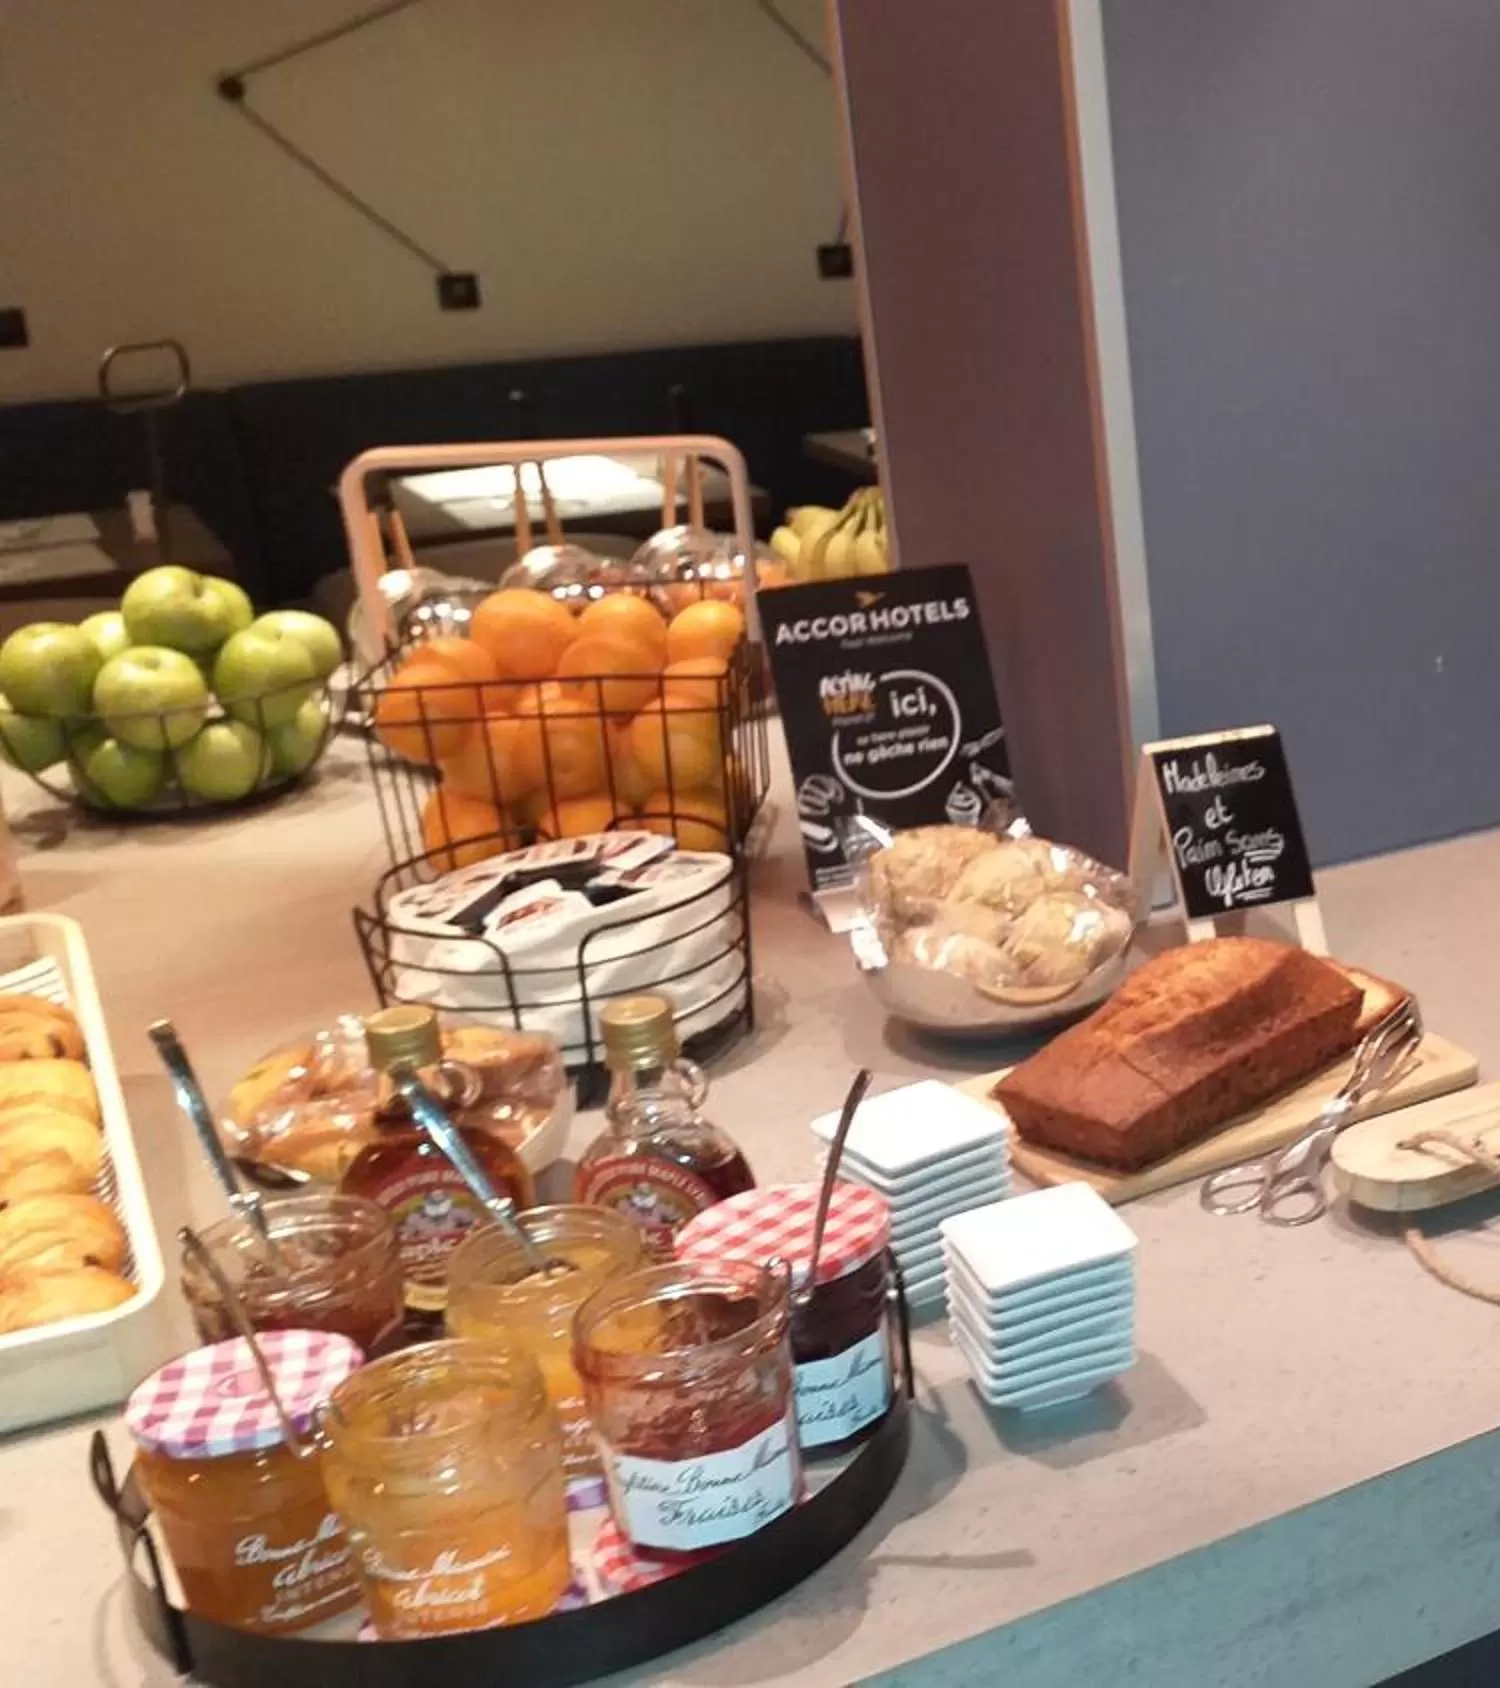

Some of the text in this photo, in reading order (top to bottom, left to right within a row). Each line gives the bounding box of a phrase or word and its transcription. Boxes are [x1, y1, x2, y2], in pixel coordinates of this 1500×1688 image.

[775, 597, 970, 646] ACCORHOTELS
[1204, 794, 1235, 829] et
[1173, 826, 1224, 869] Pain
